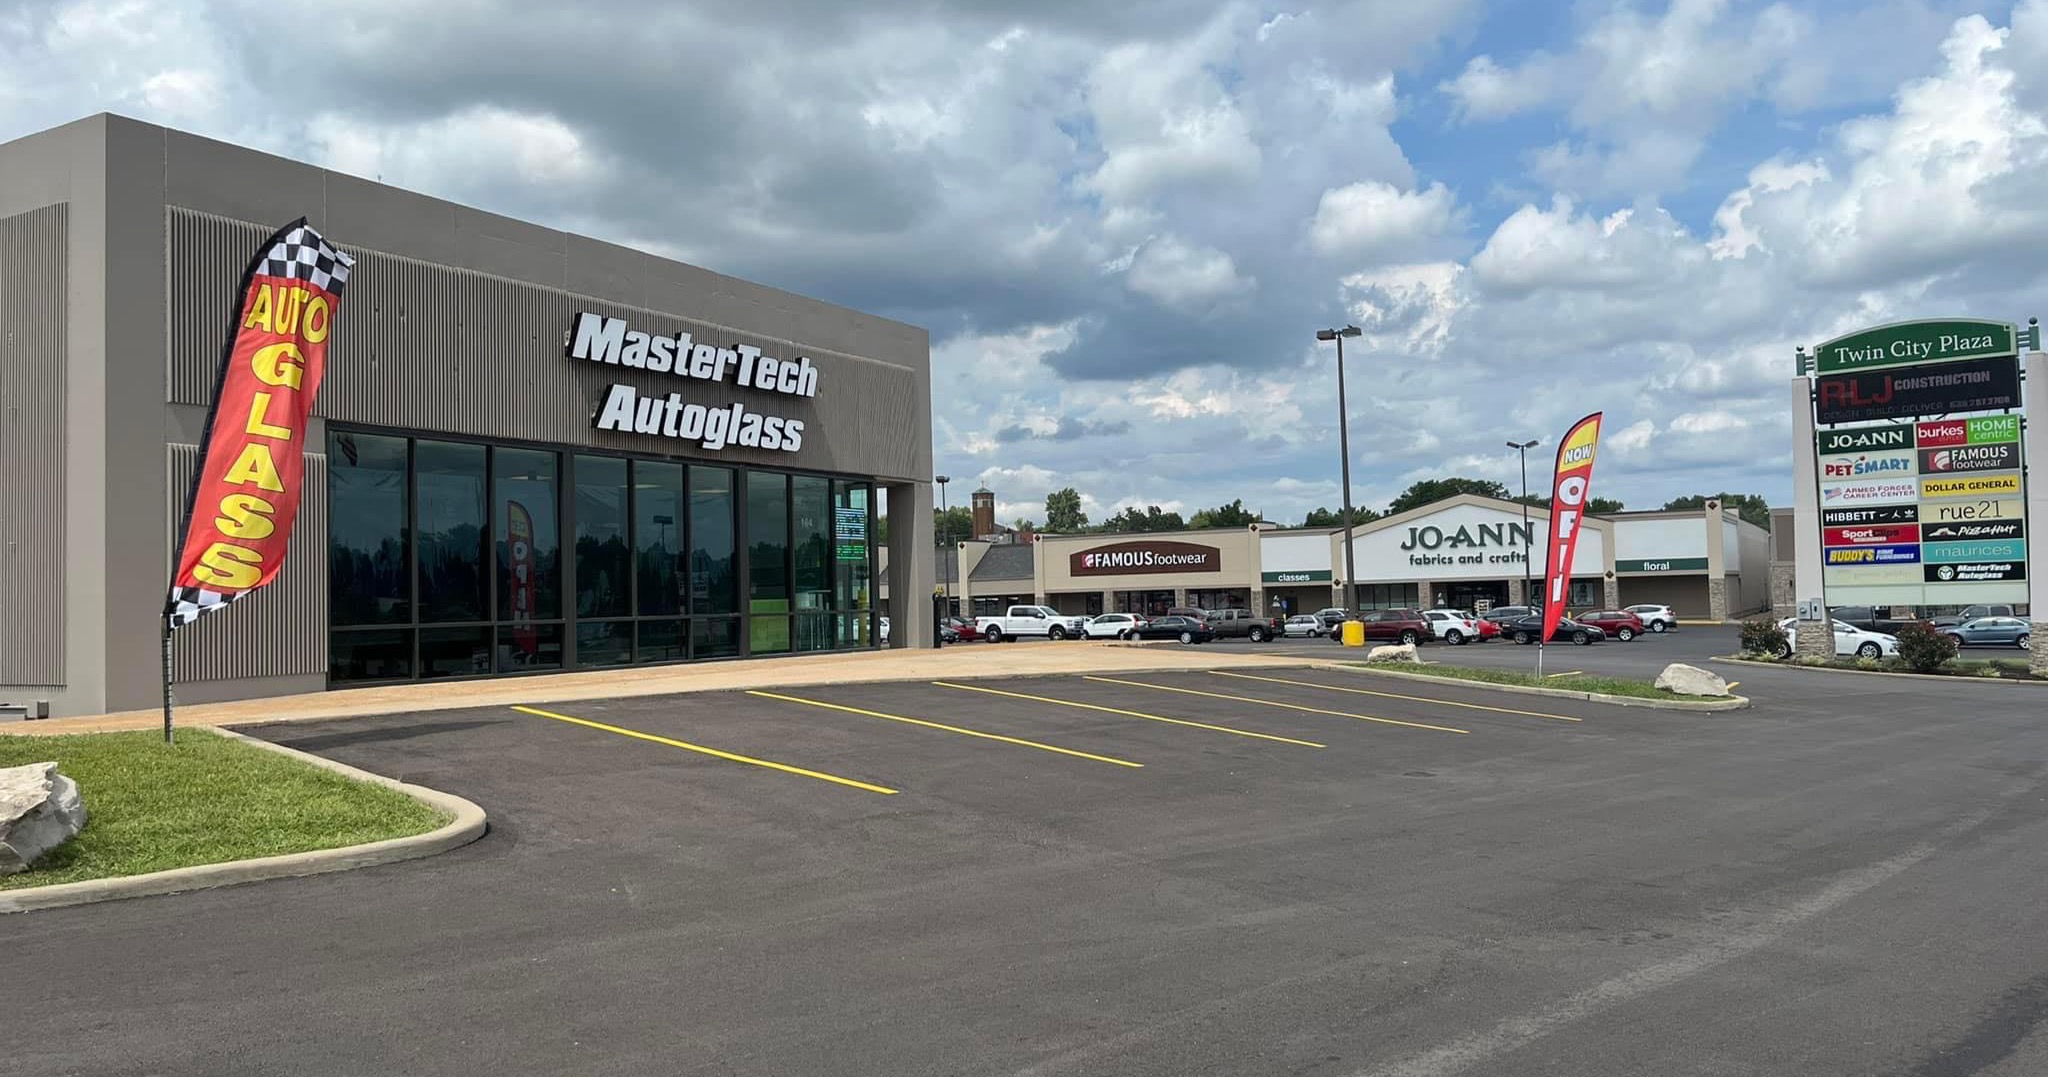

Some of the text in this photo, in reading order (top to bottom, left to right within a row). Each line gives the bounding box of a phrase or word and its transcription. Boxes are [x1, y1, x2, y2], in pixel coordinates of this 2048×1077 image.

[244, 284, 329, 344] AUTO
[571, 312, 818, 398] MasterTech
[1835, 334, 1994, 363] Twin City Plaza
[1894, 371, 1990, 391] CONSTRUCTION
[597, 384, 804, 452] Autoglass
[1971, 418, 2015, 432] HOME
[1828, 430, 1904, 448] JO-ANN
[1918, 426, 1964, 438] burkes
[1974, 430, 2013, 440] centric
[1564, 443, 1594, 465] NOW
[1952, 446, 2008, 460] FAMOUS
[192, 342, 306, 592] GLASS
[1952, 459, 2001, 469] footwear
[1878, 484, 1913, 492] FORCES
[1925, 480, 2016, 492] DOLLAR GENERAL
[1826, 511, 1876, 522] HIBBETT
[1400, 521, 1535, 550] JO-ANN
[1830, 549, 1875, 562] BUDDY'S
[1935, 545, 2012, 557] maurices
[1095, 551, 1206, 568] FAMOUS footwear
[1410, 551, 1527, 566] fabrics and crafts
[1643, 561, 1670, 571] floral
[1957, 564, 2012, 572] MasterTech
[1278, 573, 1310, 582] classes
